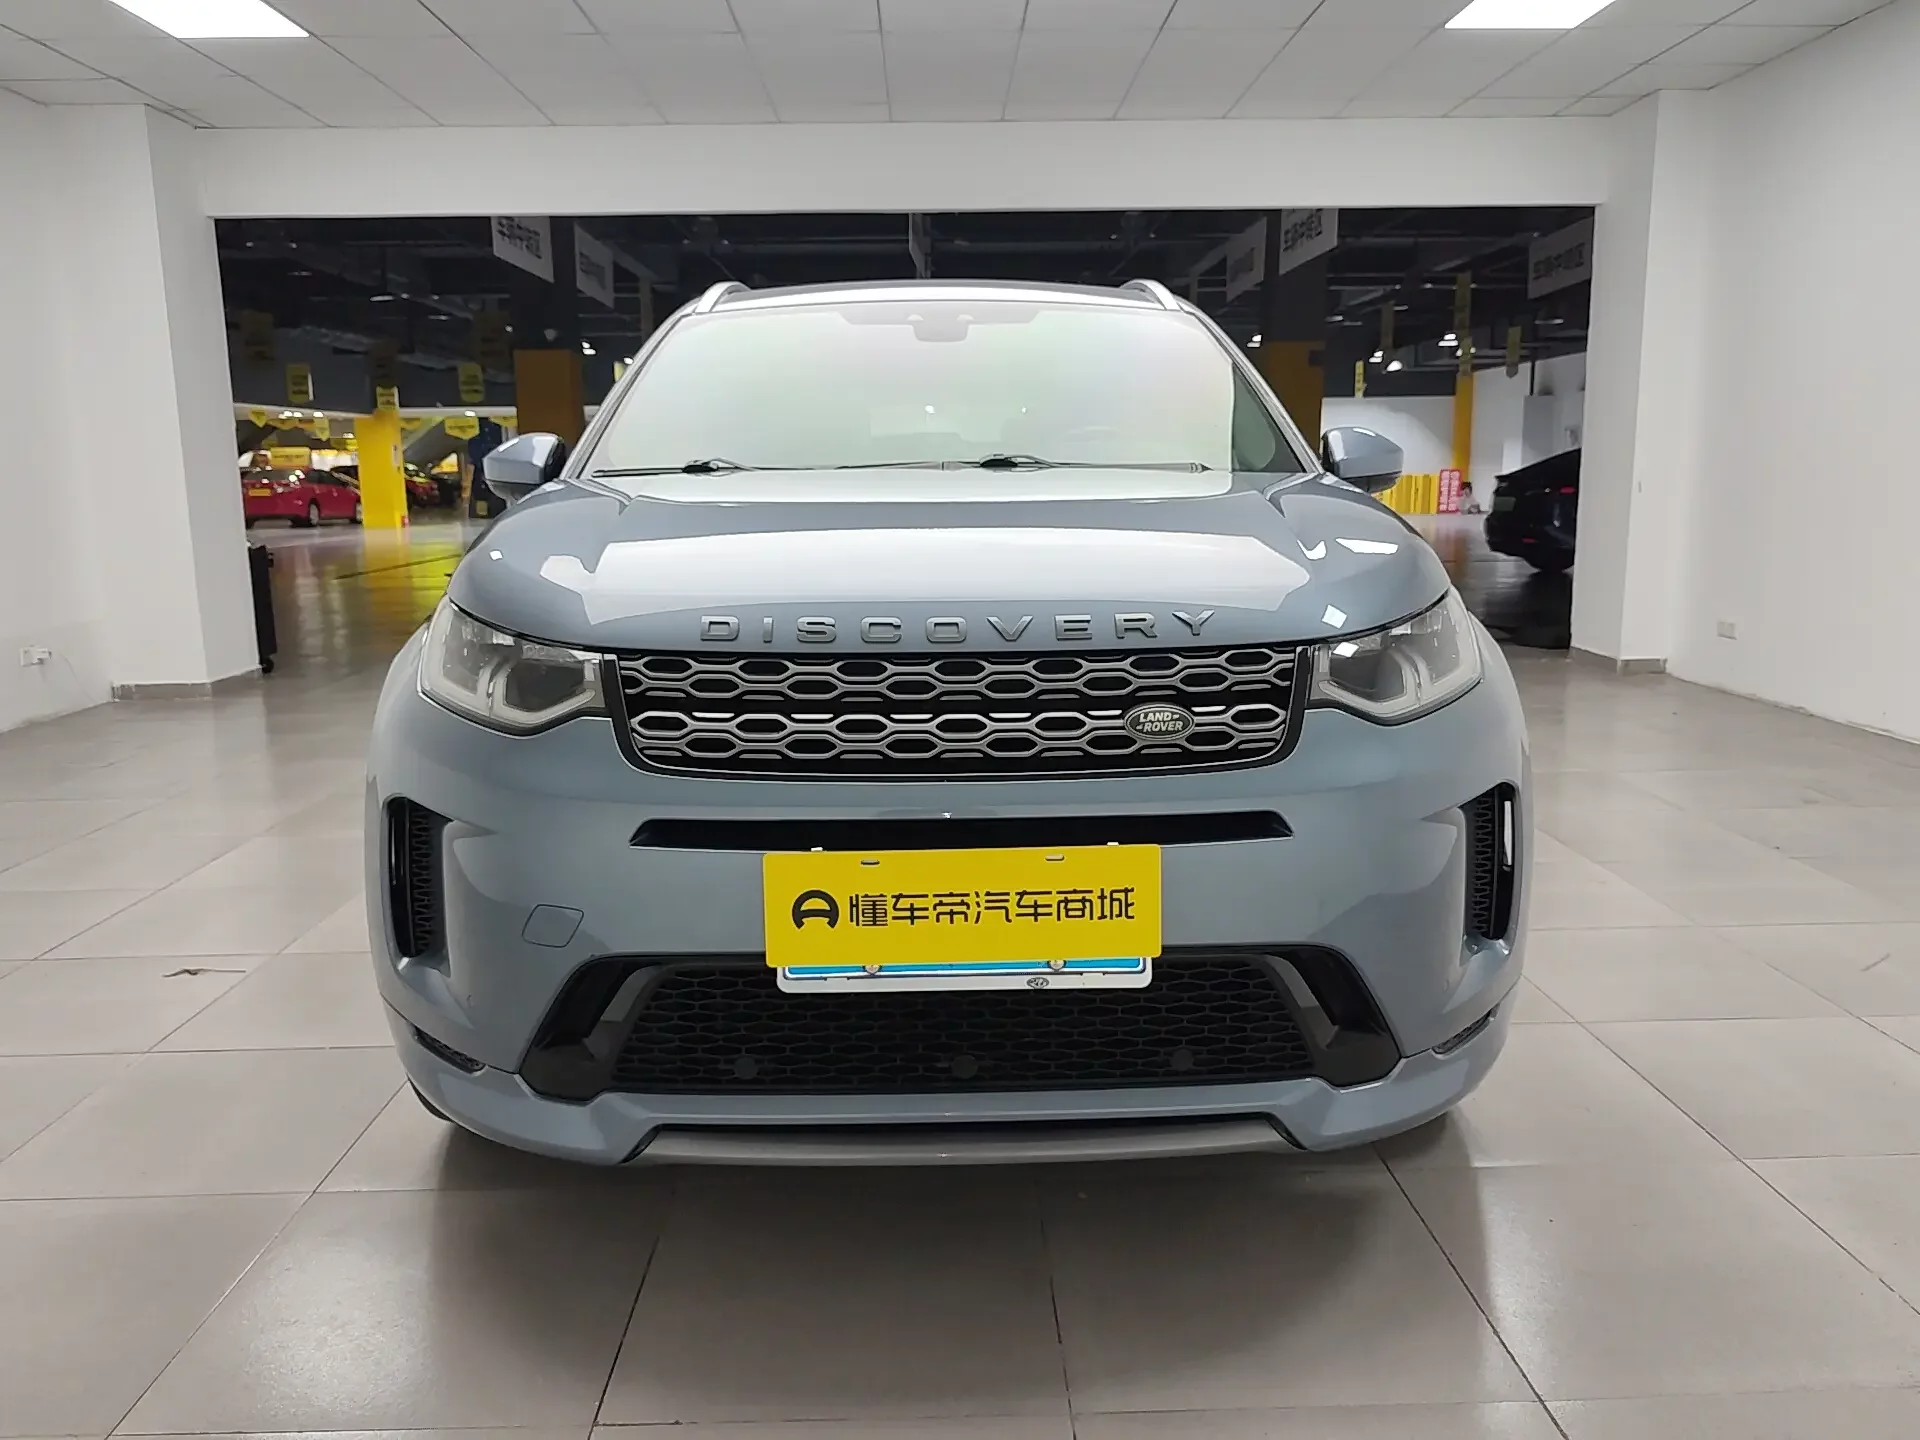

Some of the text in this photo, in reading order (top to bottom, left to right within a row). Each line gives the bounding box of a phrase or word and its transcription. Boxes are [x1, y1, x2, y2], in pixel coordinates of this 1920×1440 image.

[700, 609, 1215, 643] DISCOVERY
[1139, 711, 1172, 723] LAND
[1143, 720, 1184, 732] ROVER
[848, 886, 1136, 928] 懂车帝汽车商城
